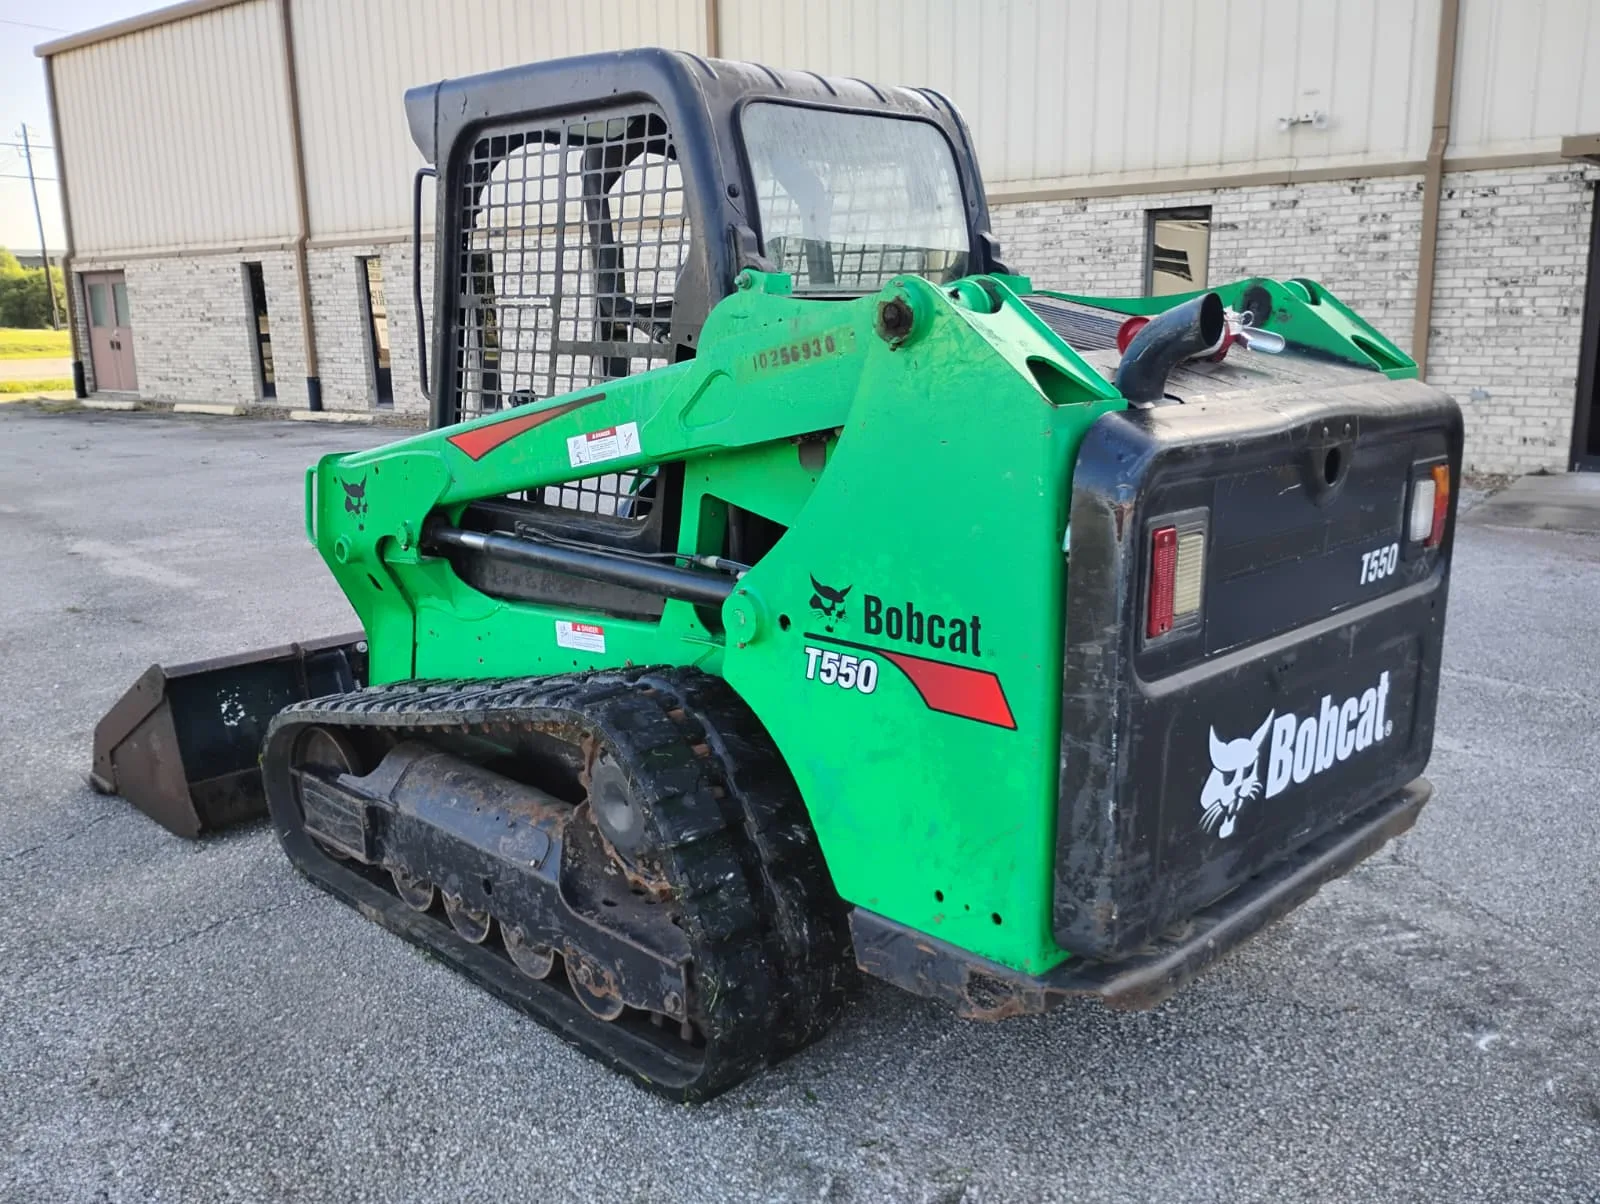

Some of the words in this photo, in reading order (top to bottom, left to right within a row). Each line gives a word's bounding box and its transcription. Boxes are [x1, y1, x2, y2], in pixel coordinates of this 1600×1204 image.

[1360, 543, 1399, 585] T550
[581, 624, 599, 634] DANGER
[863, 594, 981, 657] Bobcat
[804, 646, 878, 694] T550
[1265, 670, 1390, 799] Bobcat
